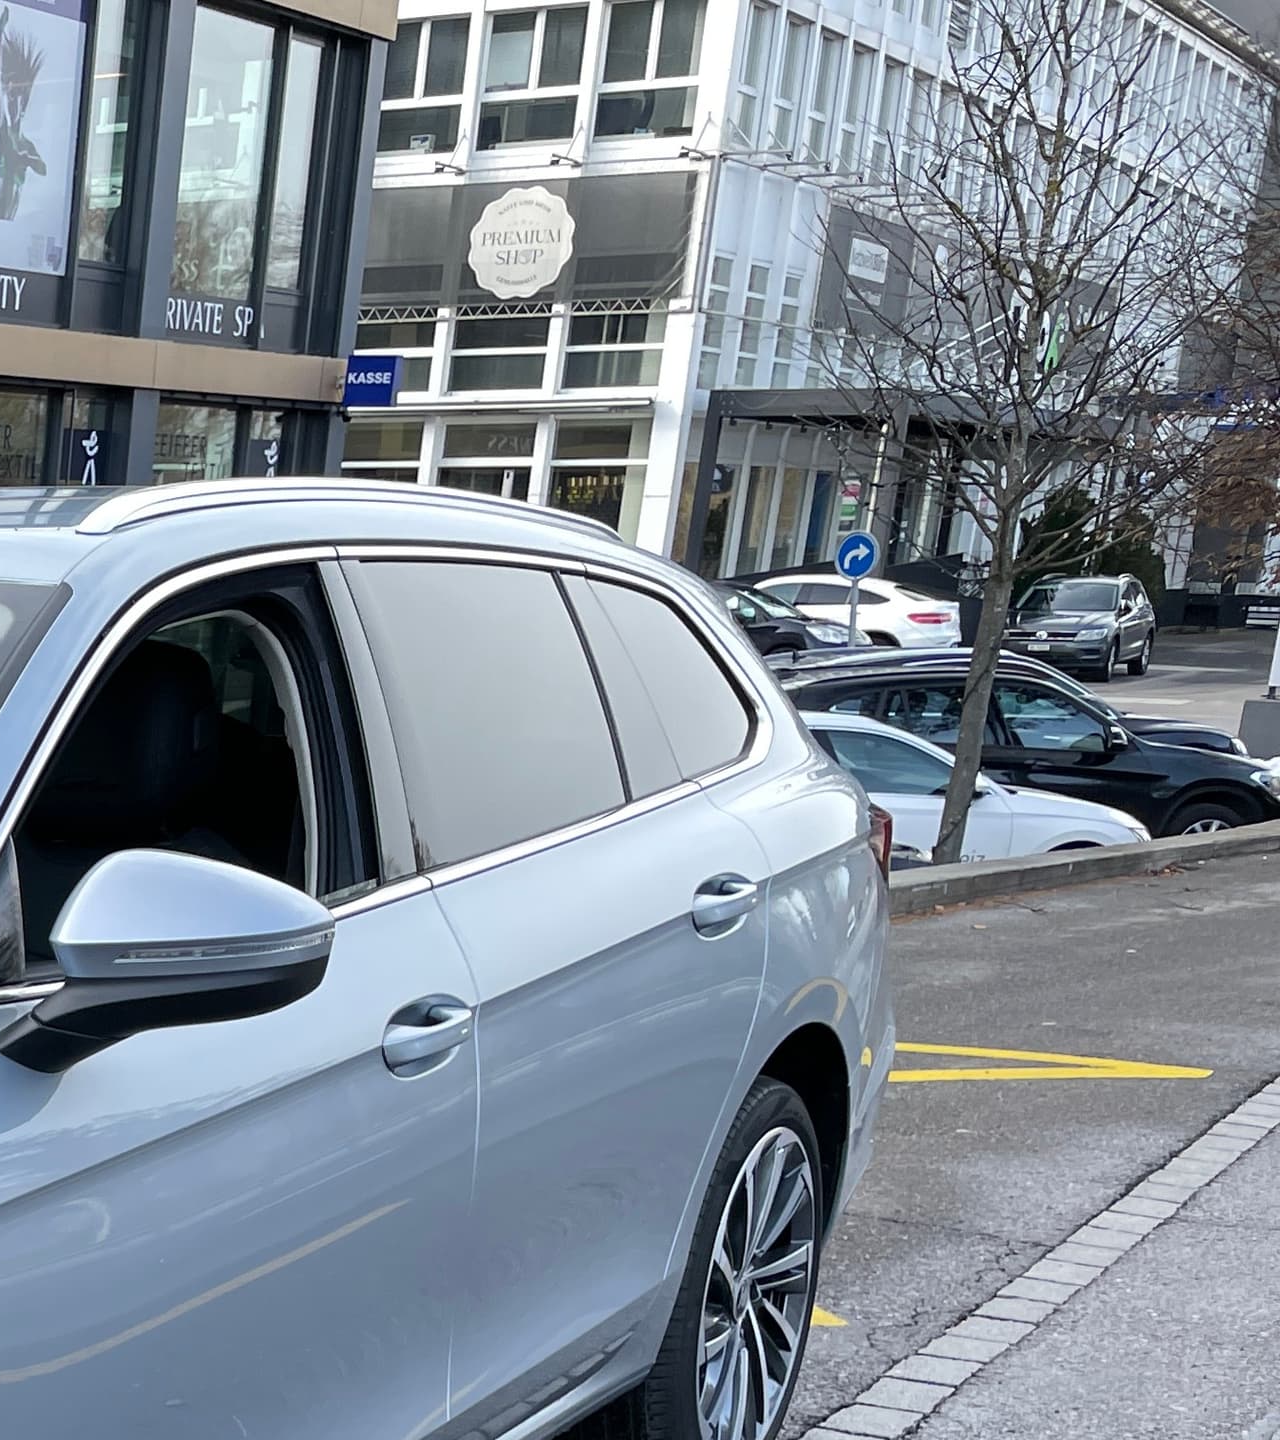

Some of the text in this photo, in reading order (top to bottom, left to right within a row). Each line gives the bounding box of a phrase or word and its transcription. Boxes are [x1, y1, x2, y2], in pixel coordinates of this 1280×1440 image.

[481, 228, 561, 248] PREMIUM
[495, 248, 544, 266] SHOP
[233, 305, 265, 339] SP
[347, 371, 392, 386] KASSE
